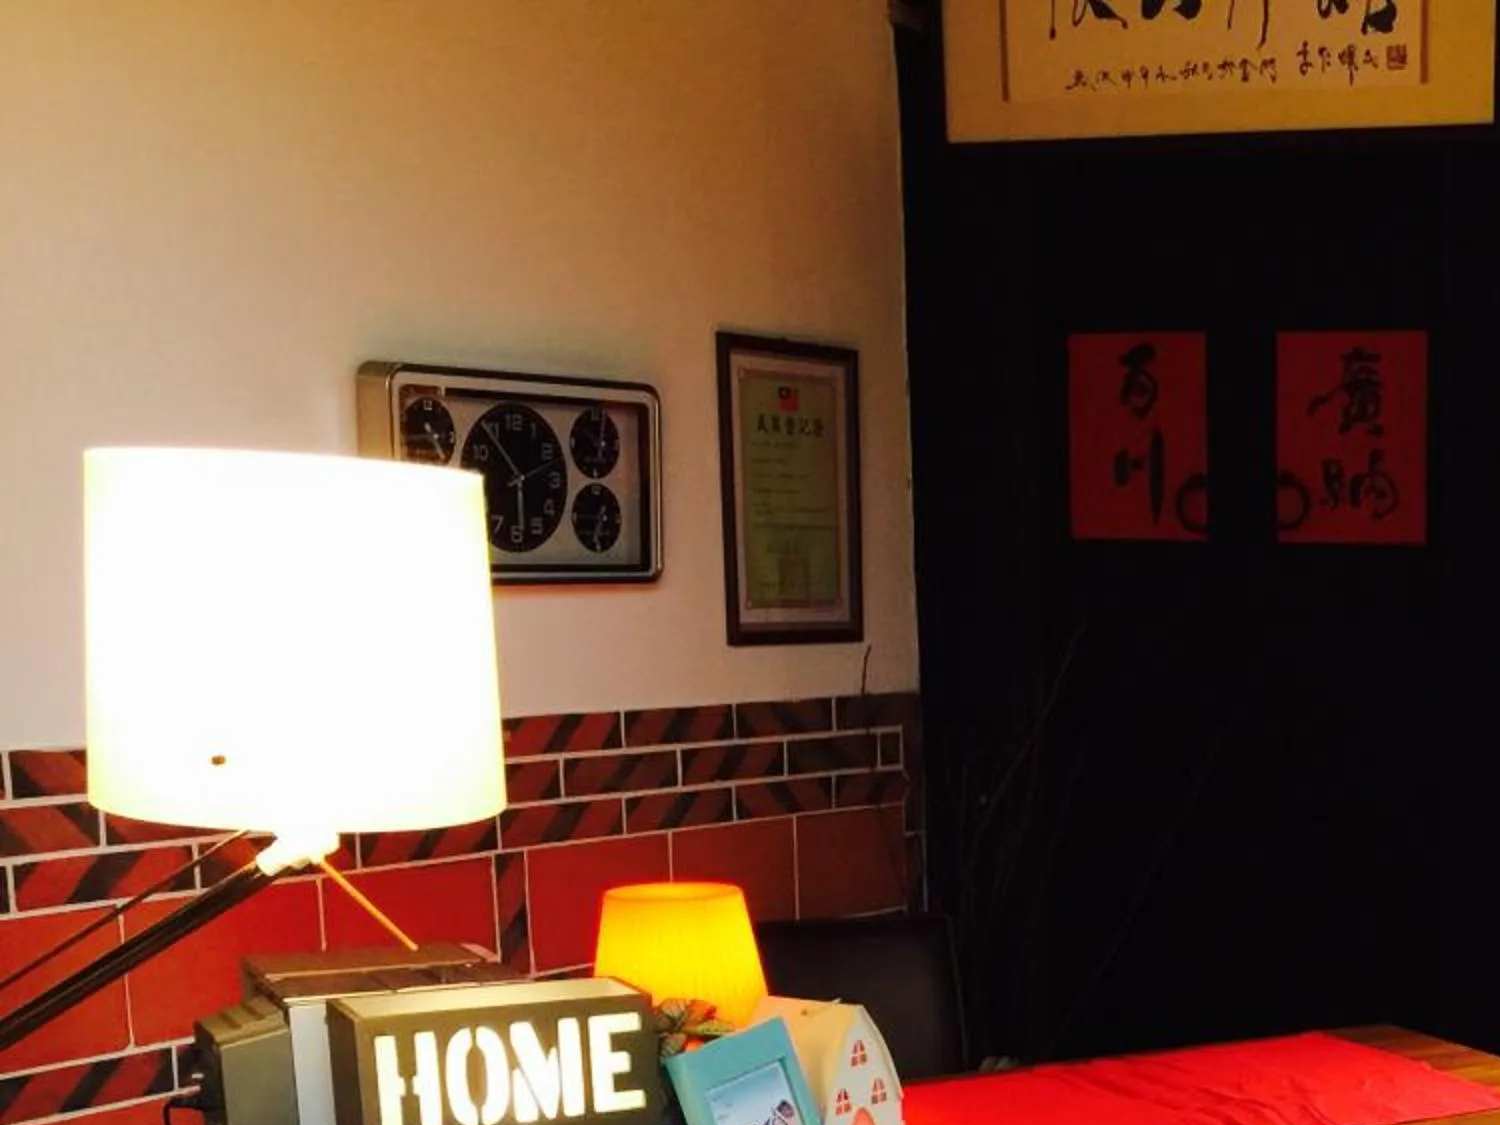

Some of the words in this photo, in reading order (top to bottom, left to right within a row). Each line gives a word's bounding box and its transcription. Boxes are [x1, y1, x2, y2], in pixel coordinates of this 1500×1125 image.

[504, 413, 524, 432] 12
[549, 471, 562, 489] 3
[510, 525, 525, 543] 6
